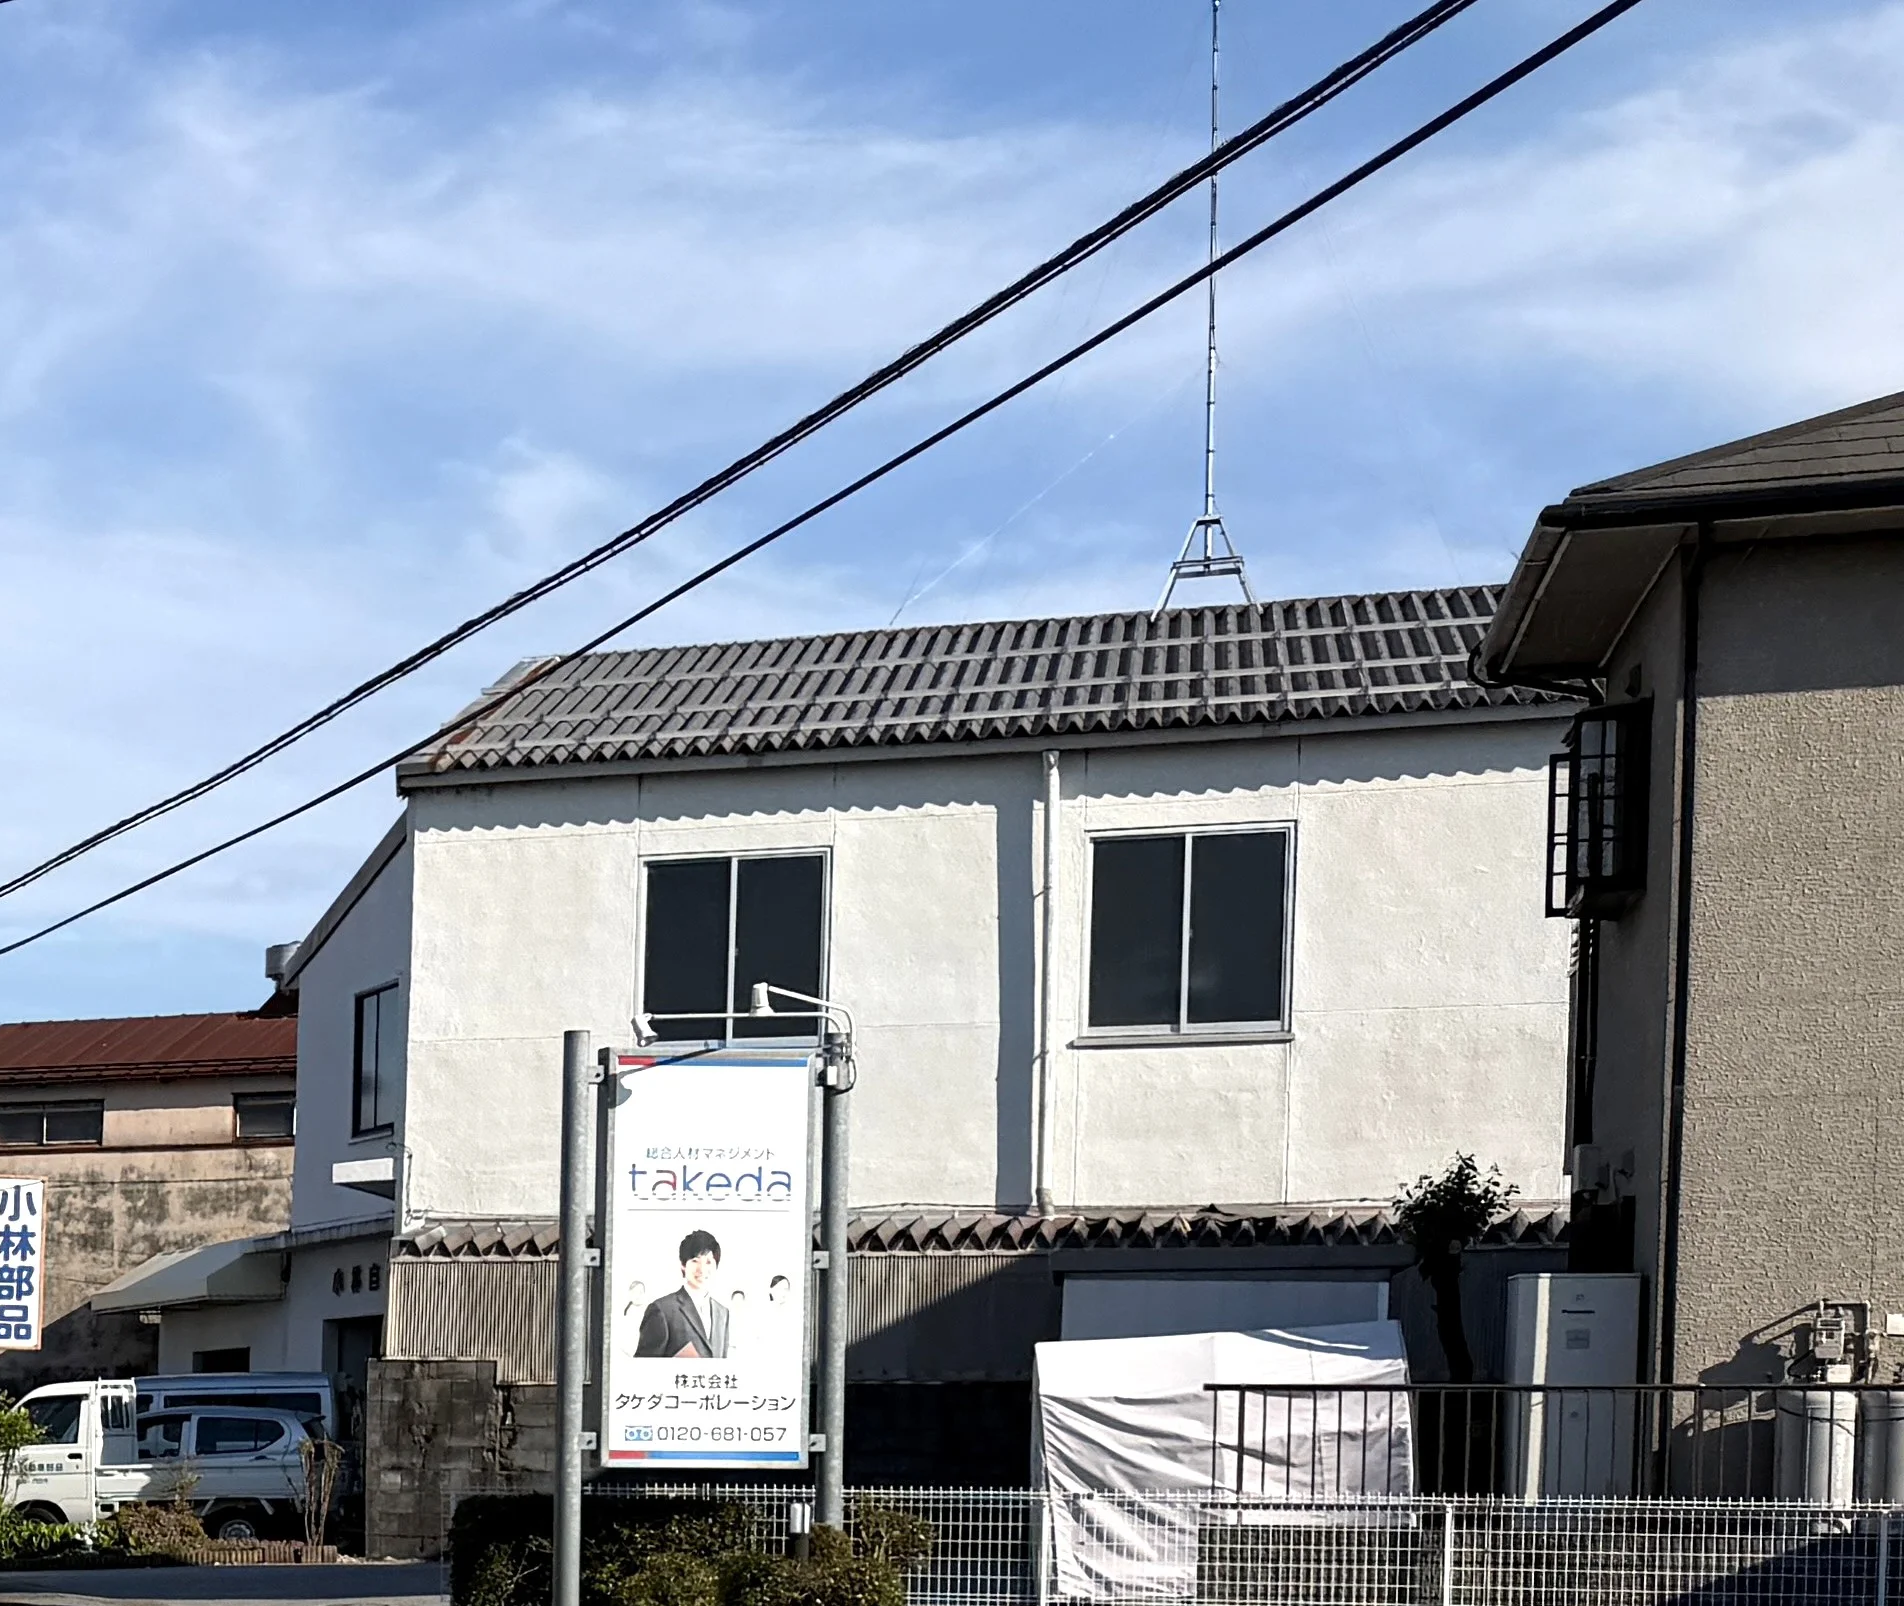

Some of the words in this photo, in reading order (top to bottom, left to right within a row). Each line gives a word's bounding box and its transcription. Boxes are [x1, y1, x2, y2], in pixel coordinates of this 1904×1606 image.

[646, 1147, 775, 1160] 総合人材マネジメント
[628, 1163, 792, 1202] takeda
[675, 1374, 738, 1389] 株式会社
[615, 1393, 796, 1411] タケダコーポレーション
[657, 1426, 787, 1441] 0120-681-057
